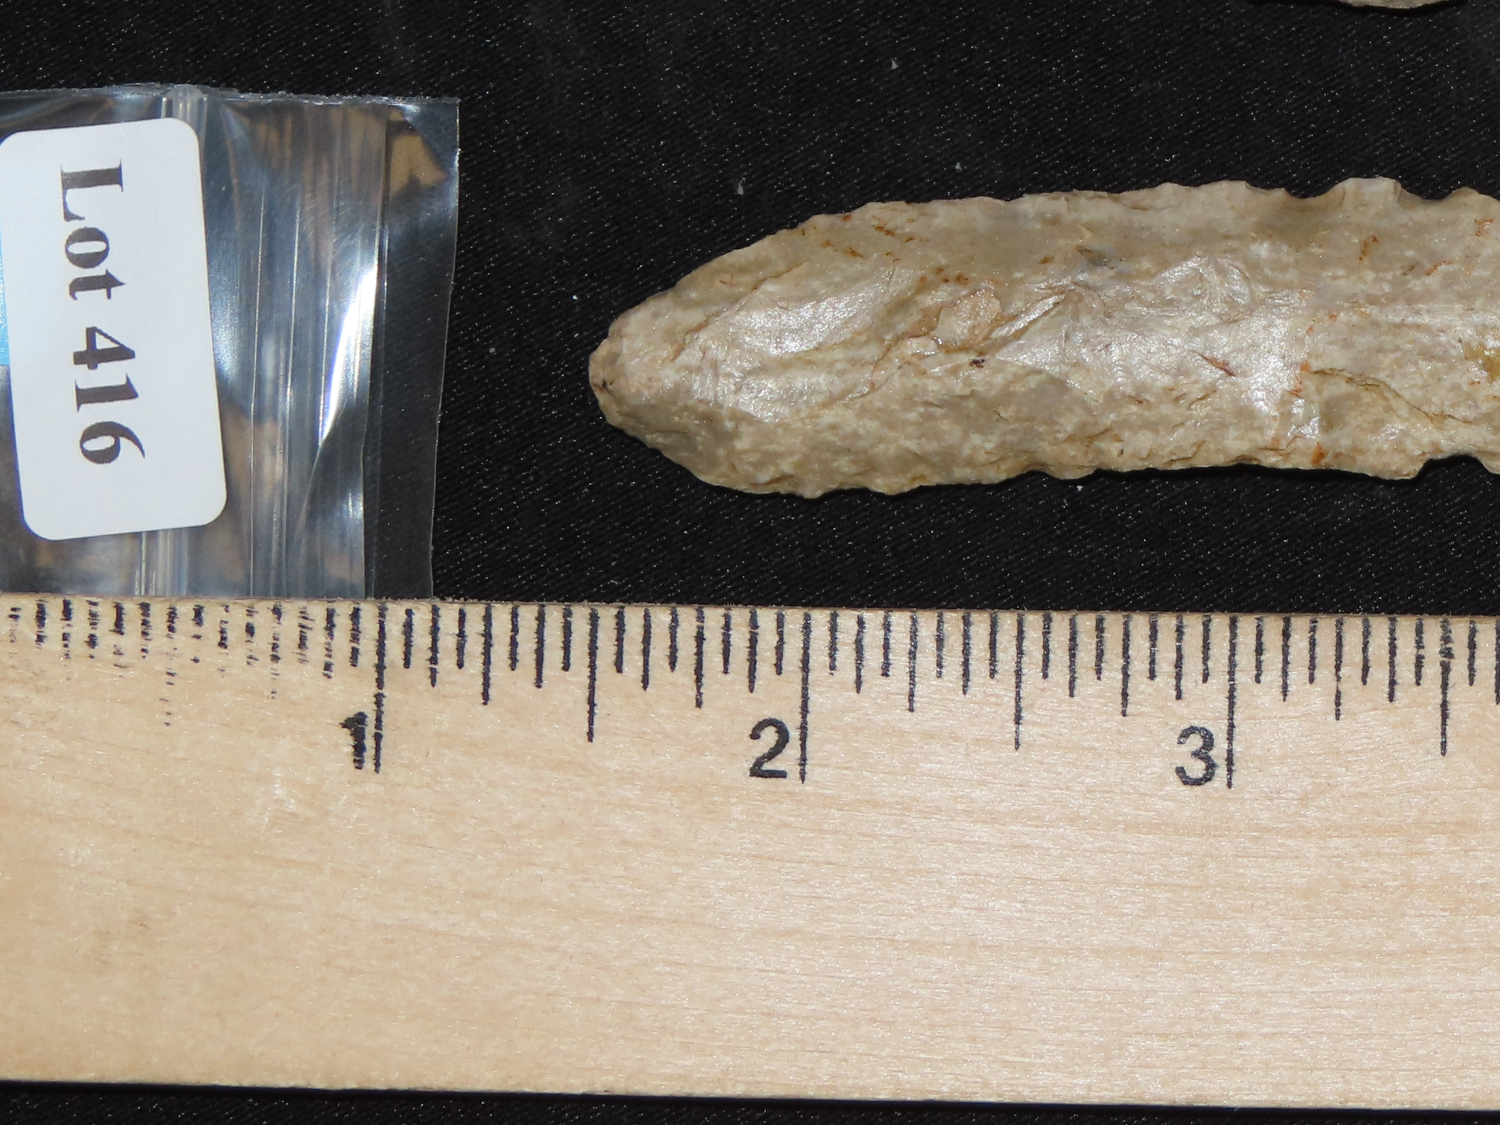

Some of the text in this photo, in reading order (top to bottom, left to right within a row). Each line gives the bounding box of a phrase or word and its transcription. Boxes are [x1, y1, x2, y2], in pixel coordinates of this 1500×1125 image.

[60, 158, 146, 465] Lot 416
[340, 711, 367, 770] 1
[748, 718, 790, 779] 2
[1174, 725, 1217, 787] 3
